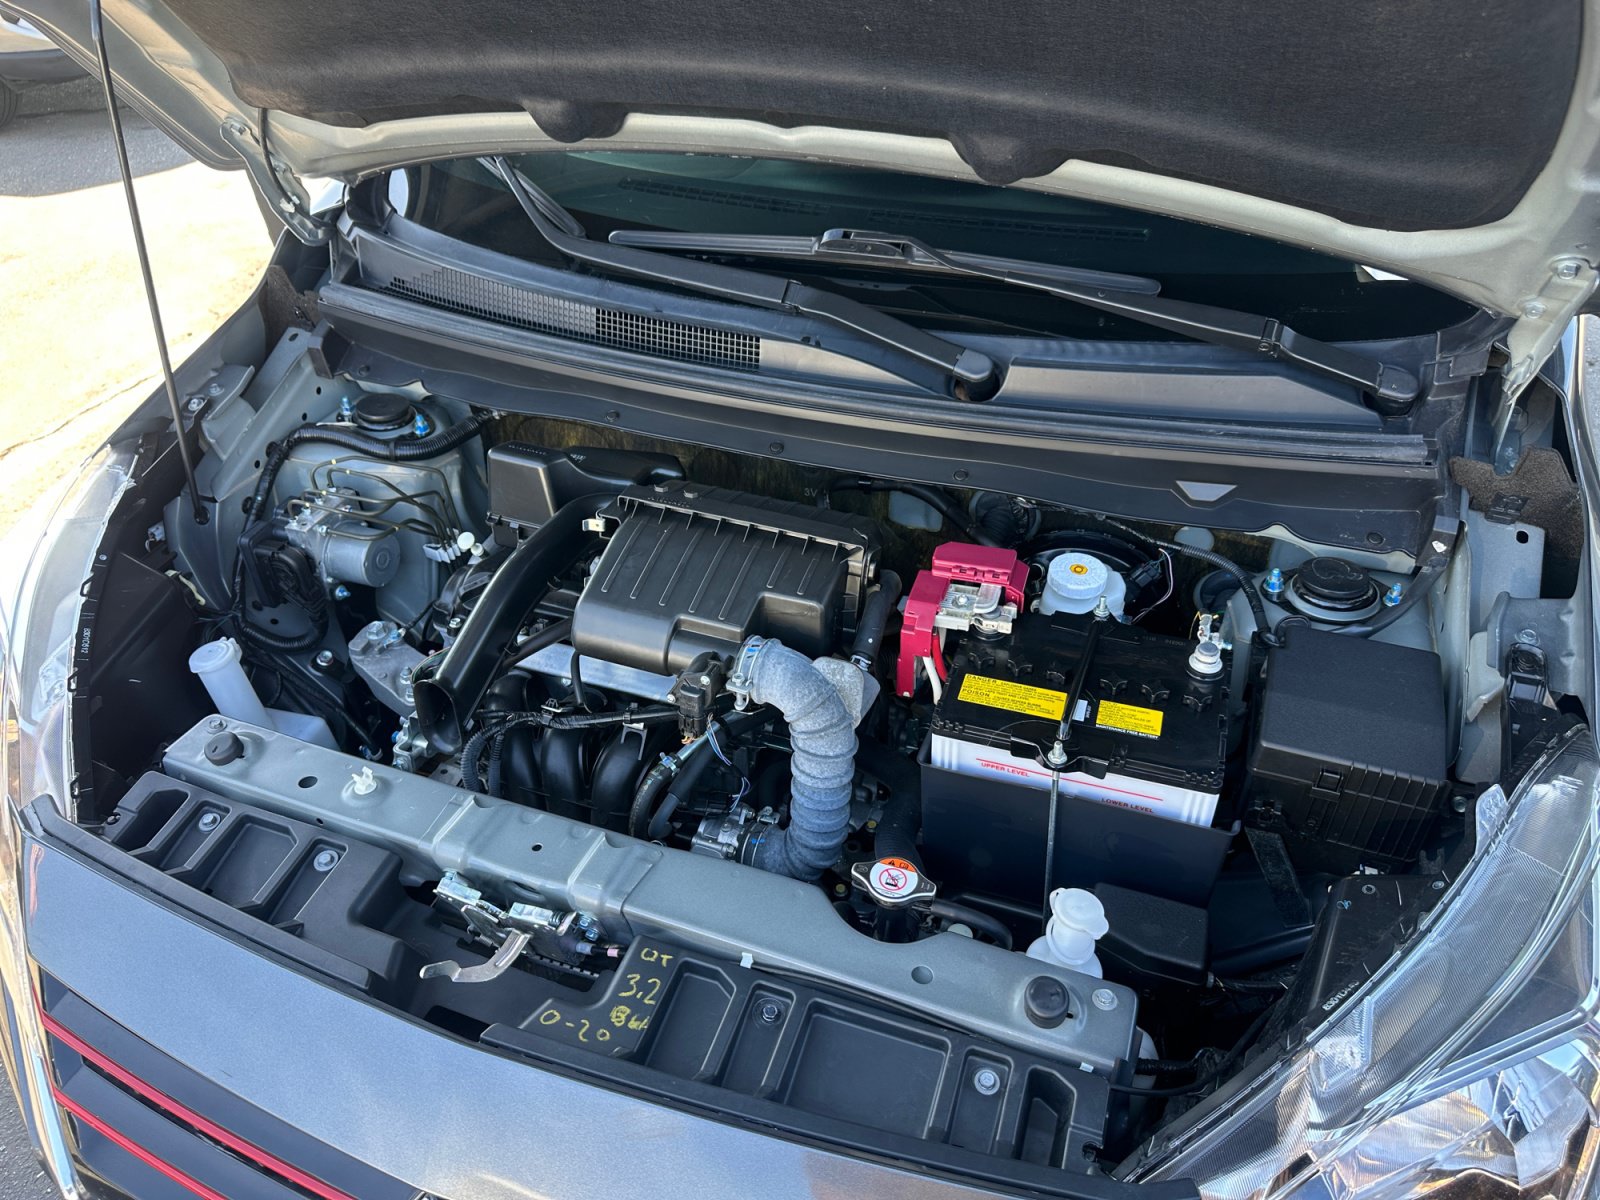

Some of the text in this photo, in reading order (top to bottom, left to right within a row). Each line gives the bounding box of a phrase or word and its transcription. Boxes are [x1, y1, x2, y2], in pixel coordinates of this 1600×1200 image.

[966, 675, 997, 683] DANGER
[962, 688, 991, 697] POISON
[981, 762, 1030, 778] UPPER LEVEL
[1101, 798, 1154, 813] LOWER LEVEL
[618, 973, 661, 1005] 3.2
[539, 1009, 611, 1043] 0-20
